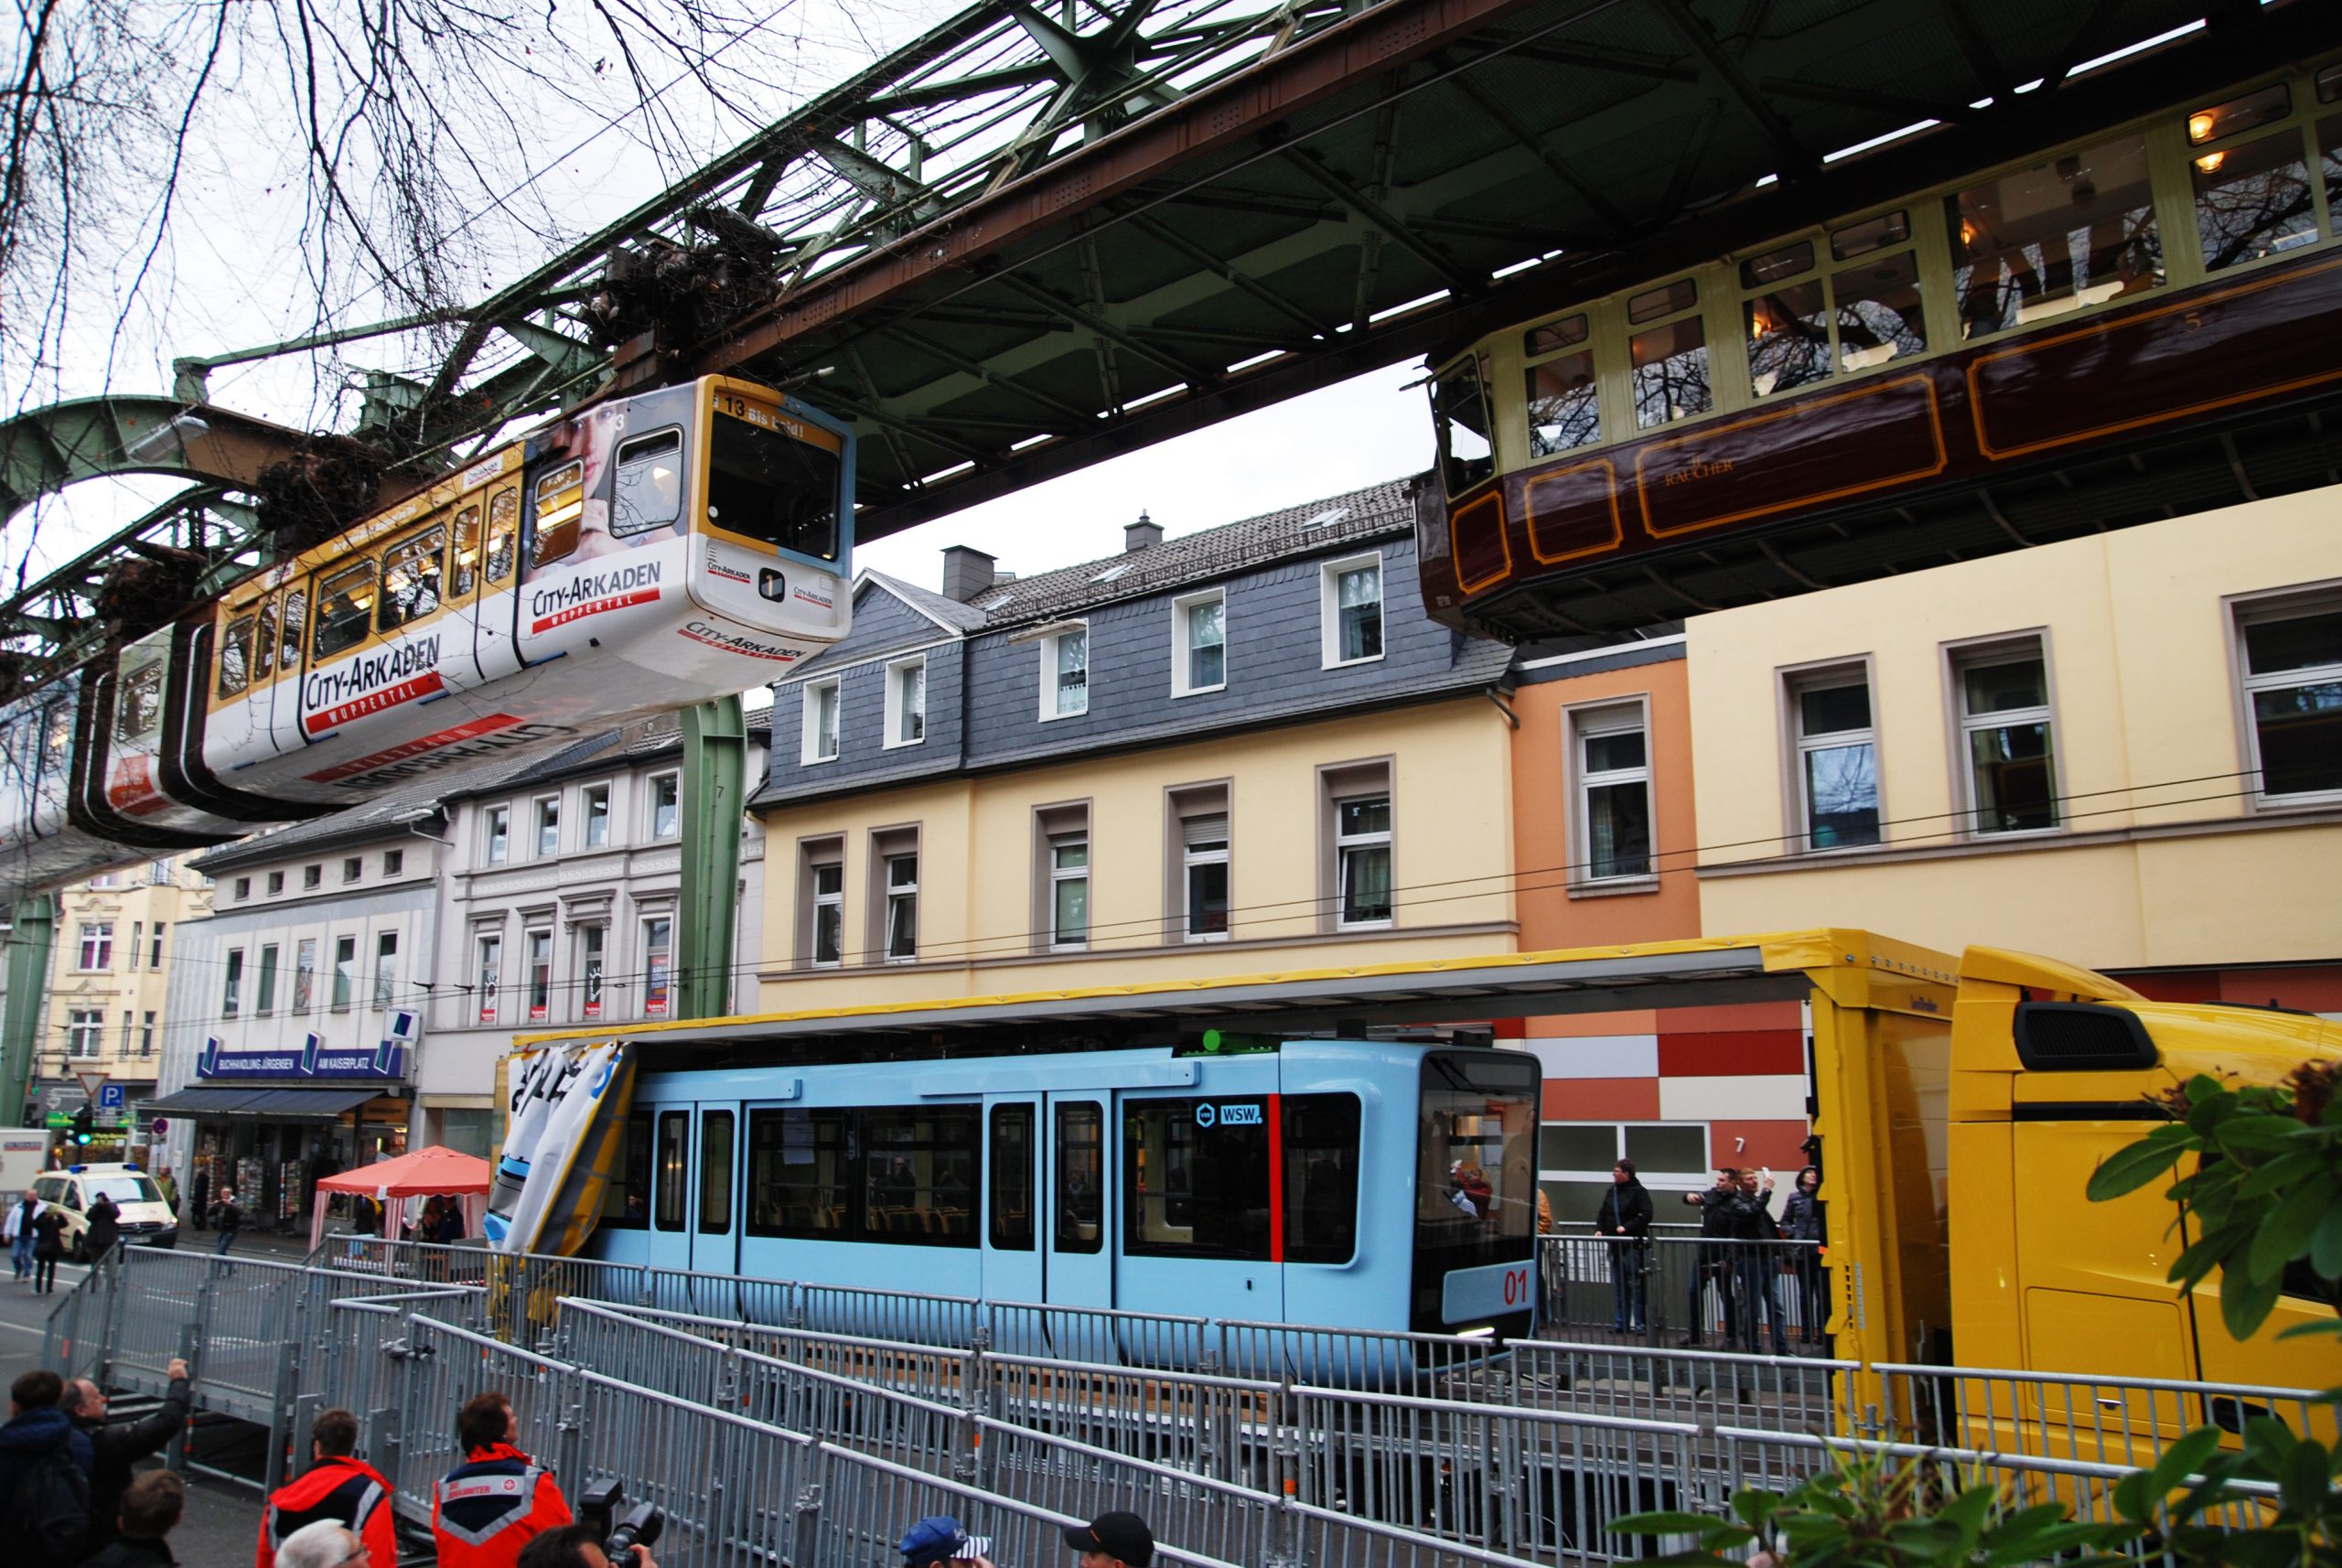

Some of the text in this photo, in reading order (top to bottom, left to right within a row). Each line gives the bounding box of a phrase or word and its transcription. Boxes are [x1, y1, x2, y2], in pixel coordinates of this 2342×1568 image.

[616, 413, 626, 431] 3
[725, 395, 746, 416] 13
[747, 408, 768, 426] Bis
[532, 561, 661, 618] CITY-ARKADEN
[766, 574, 774, 597] 1
[551, 596, 633, 626] WUPPERTAL
[686, 621, 807, 658] CITY-ARKADEN
[306, 633, 441, 711] CITY-ARKADEN
[328, 682, 416, 724] WUPPERTAL
[716, 785, 725, 799] 7
[328, 1057, 370, 1069] KAISERPLATZ
[106, 1087, 119, 1104] P
[1223, 1108, 1255, 1122] WSW
[1735, 1136, 1746, 1153] 7
[1504, 1269, 1527, 1305] 01
